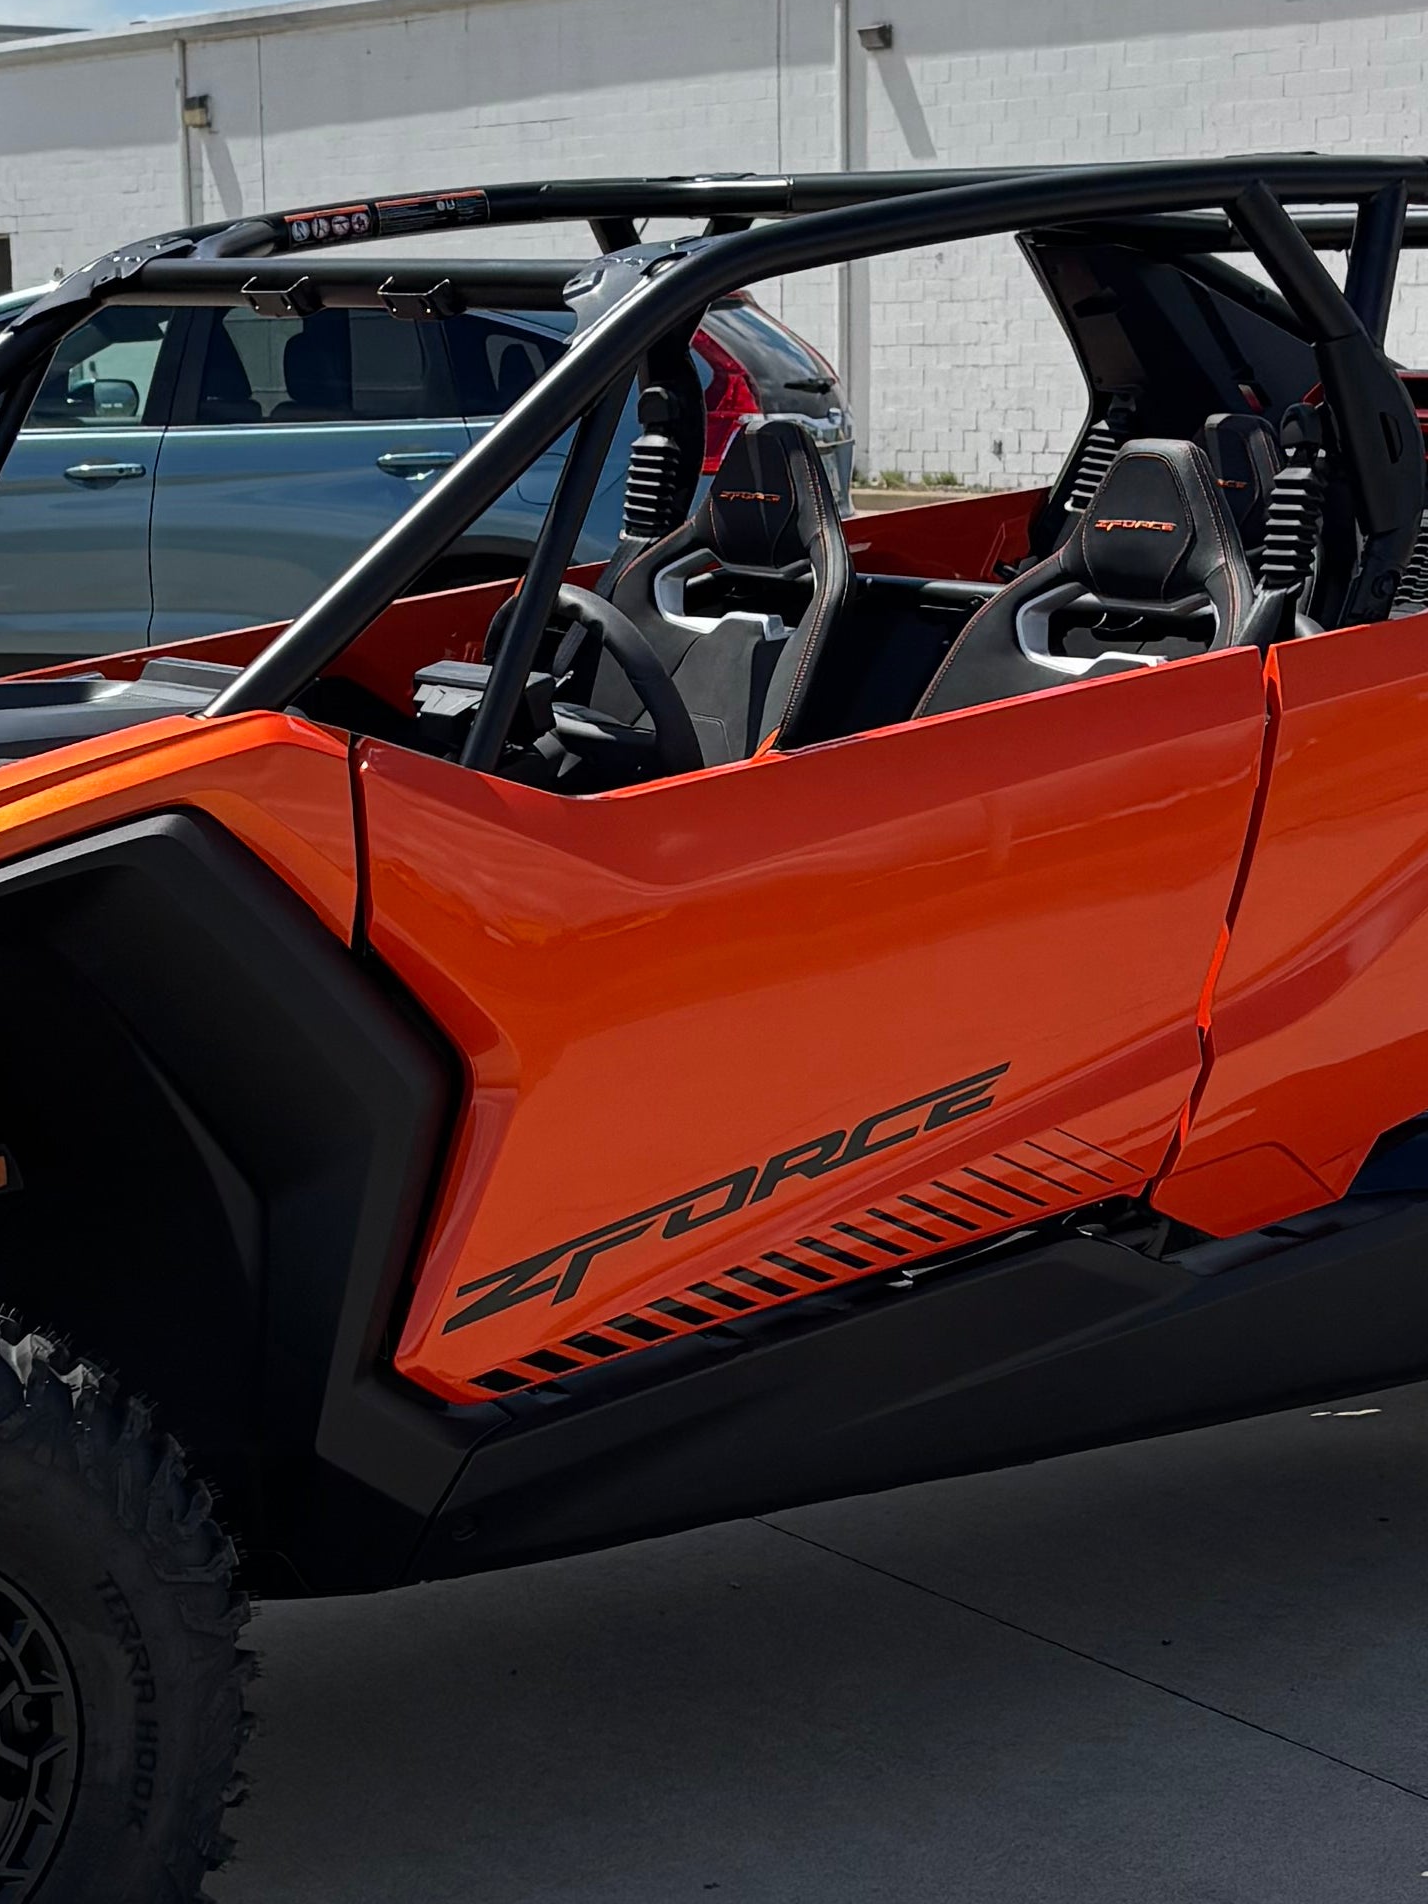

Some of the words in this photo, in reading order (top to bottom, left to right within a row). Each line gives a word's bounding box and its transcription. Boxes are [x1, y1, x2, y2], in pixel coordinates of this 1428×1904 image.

[1094, 519, 1178, 532] ZFORCE
[441, 1060, 1012, 1335] ZFORCE
[93, 1571, 156, 1704] TERRA
[126, 1720, 159, 1833] HOOK
